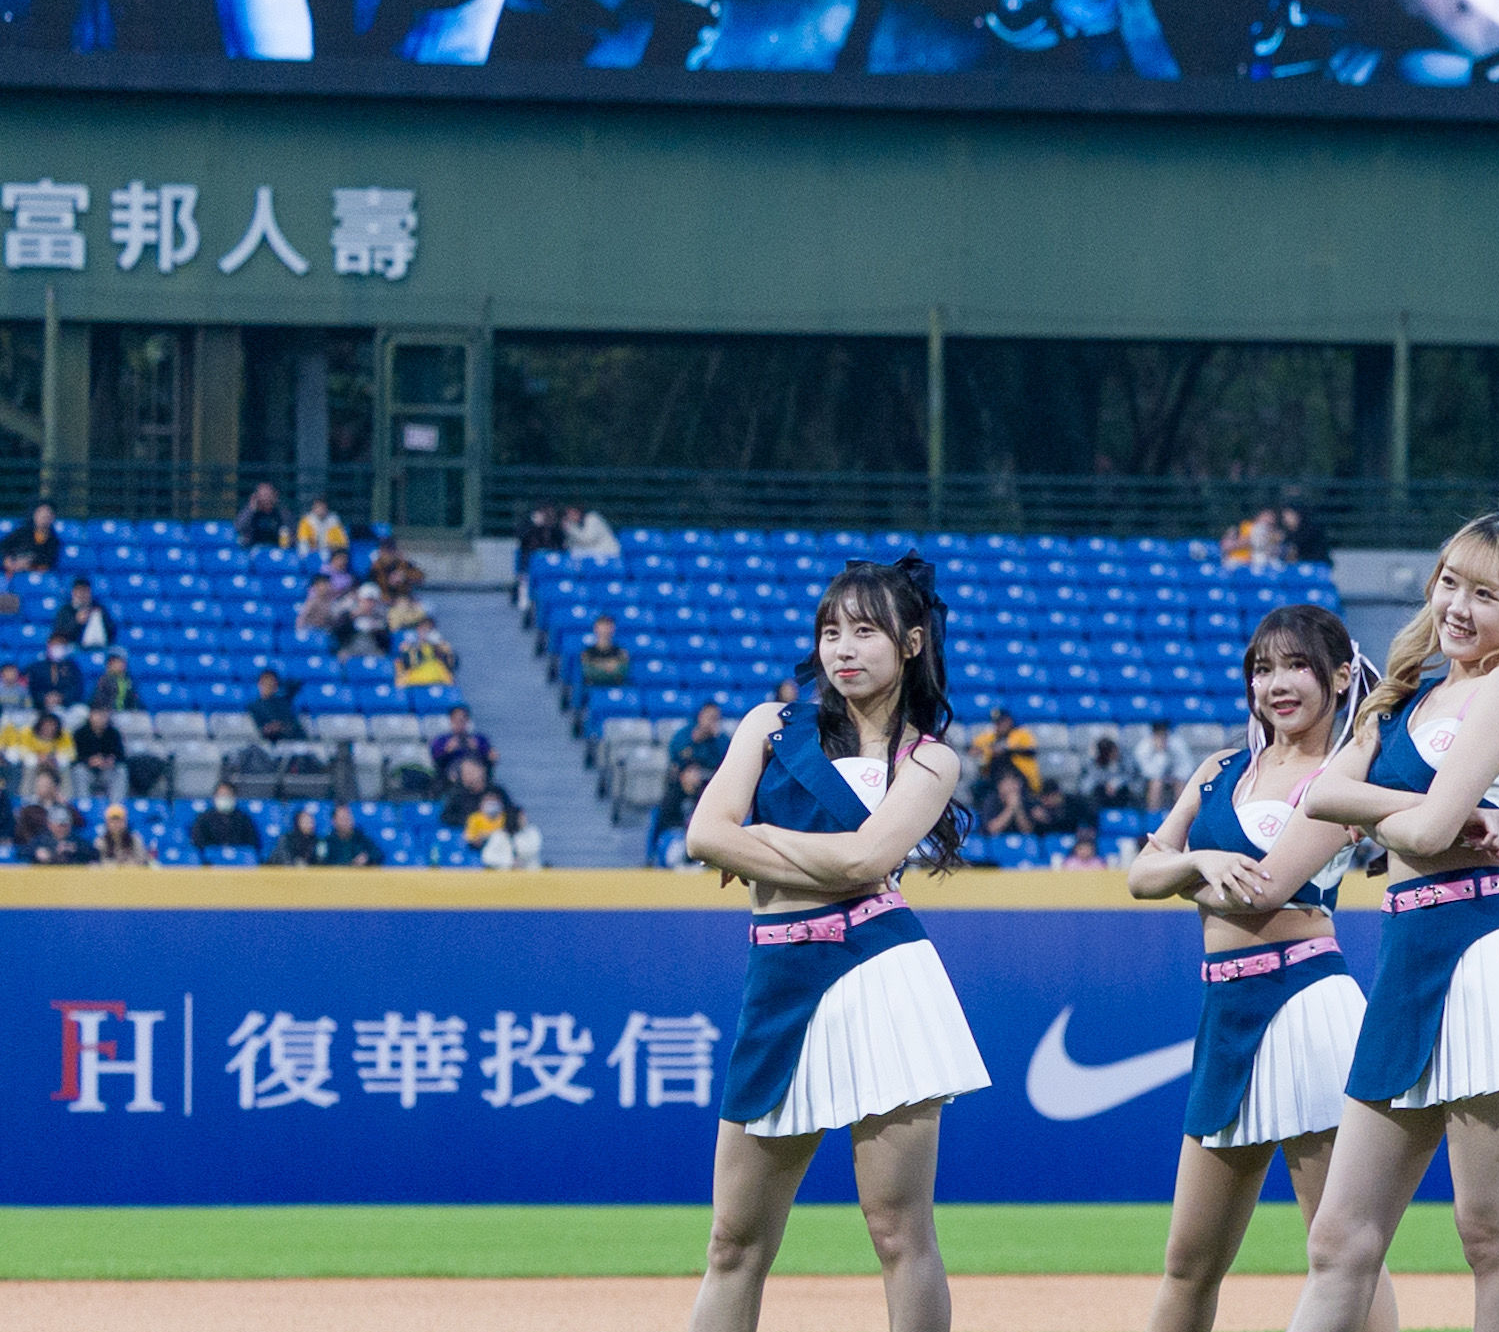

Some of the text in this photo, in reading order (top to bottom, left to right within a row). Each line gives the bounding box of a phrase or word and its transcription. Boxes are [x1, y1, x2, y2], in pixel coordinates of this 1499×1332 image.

[2, 178, 419, 279] 富邦人壽
[224, 1010, 719, 1110] 復華投信
